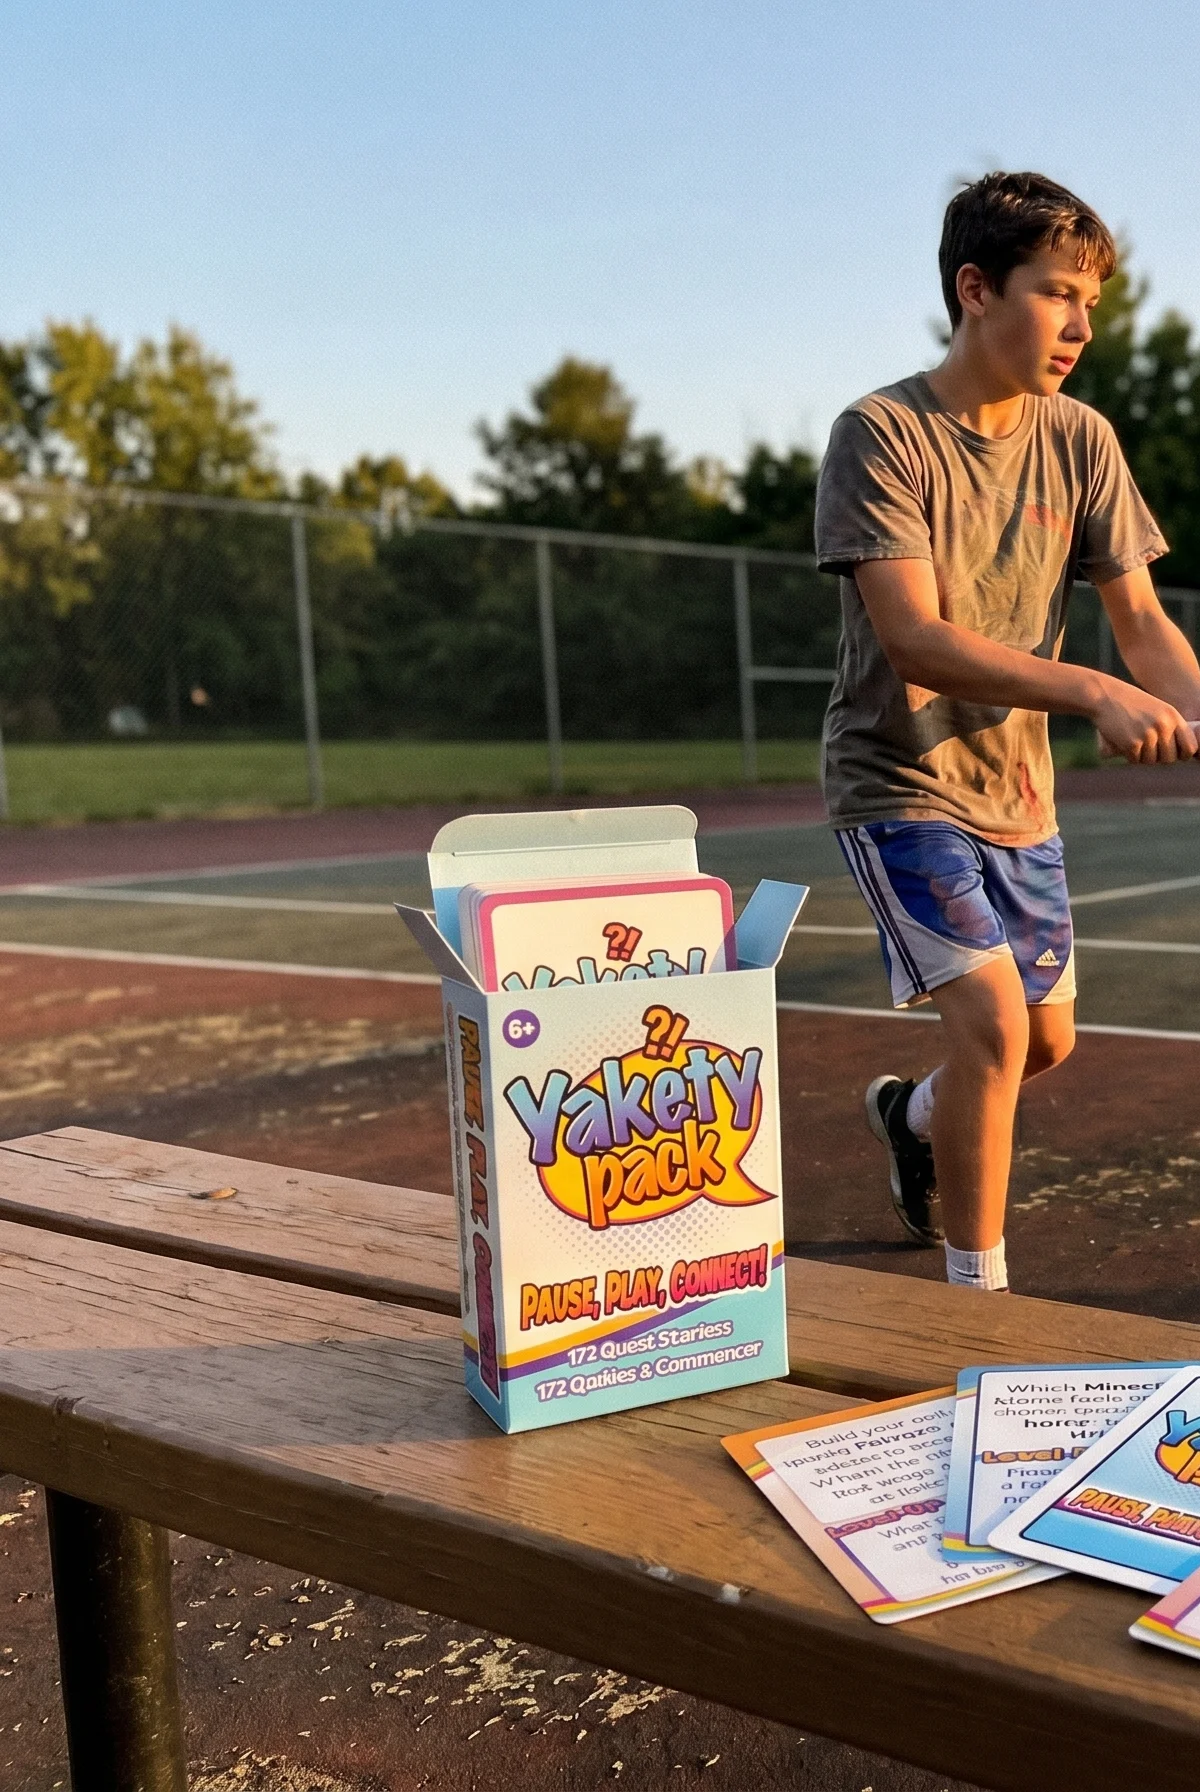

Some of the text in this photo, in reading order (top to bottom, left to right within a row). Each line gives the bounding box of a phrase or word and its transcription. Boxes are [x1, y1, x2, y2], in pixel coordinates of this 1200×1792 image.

[508, 1019, 536, 1039] 6+
[503, 1046, 763, 1166] Yakety
[582, 1118, 726, 1231] pack
[520, 1243, 769, 1331] PAUSE, PLAY, CONNECT!
[537, 1380, 567, 1401] 172
[640, 1363, 653, 1379] &
[656, 1341, 763, 1375] Commencer
[568, 1346, 597, 1366] 172
[601, 1336, 656, 1361] Quest
[1006, 1383, 1076, 1393] Which
[861, 1419, 905, 1438] your
